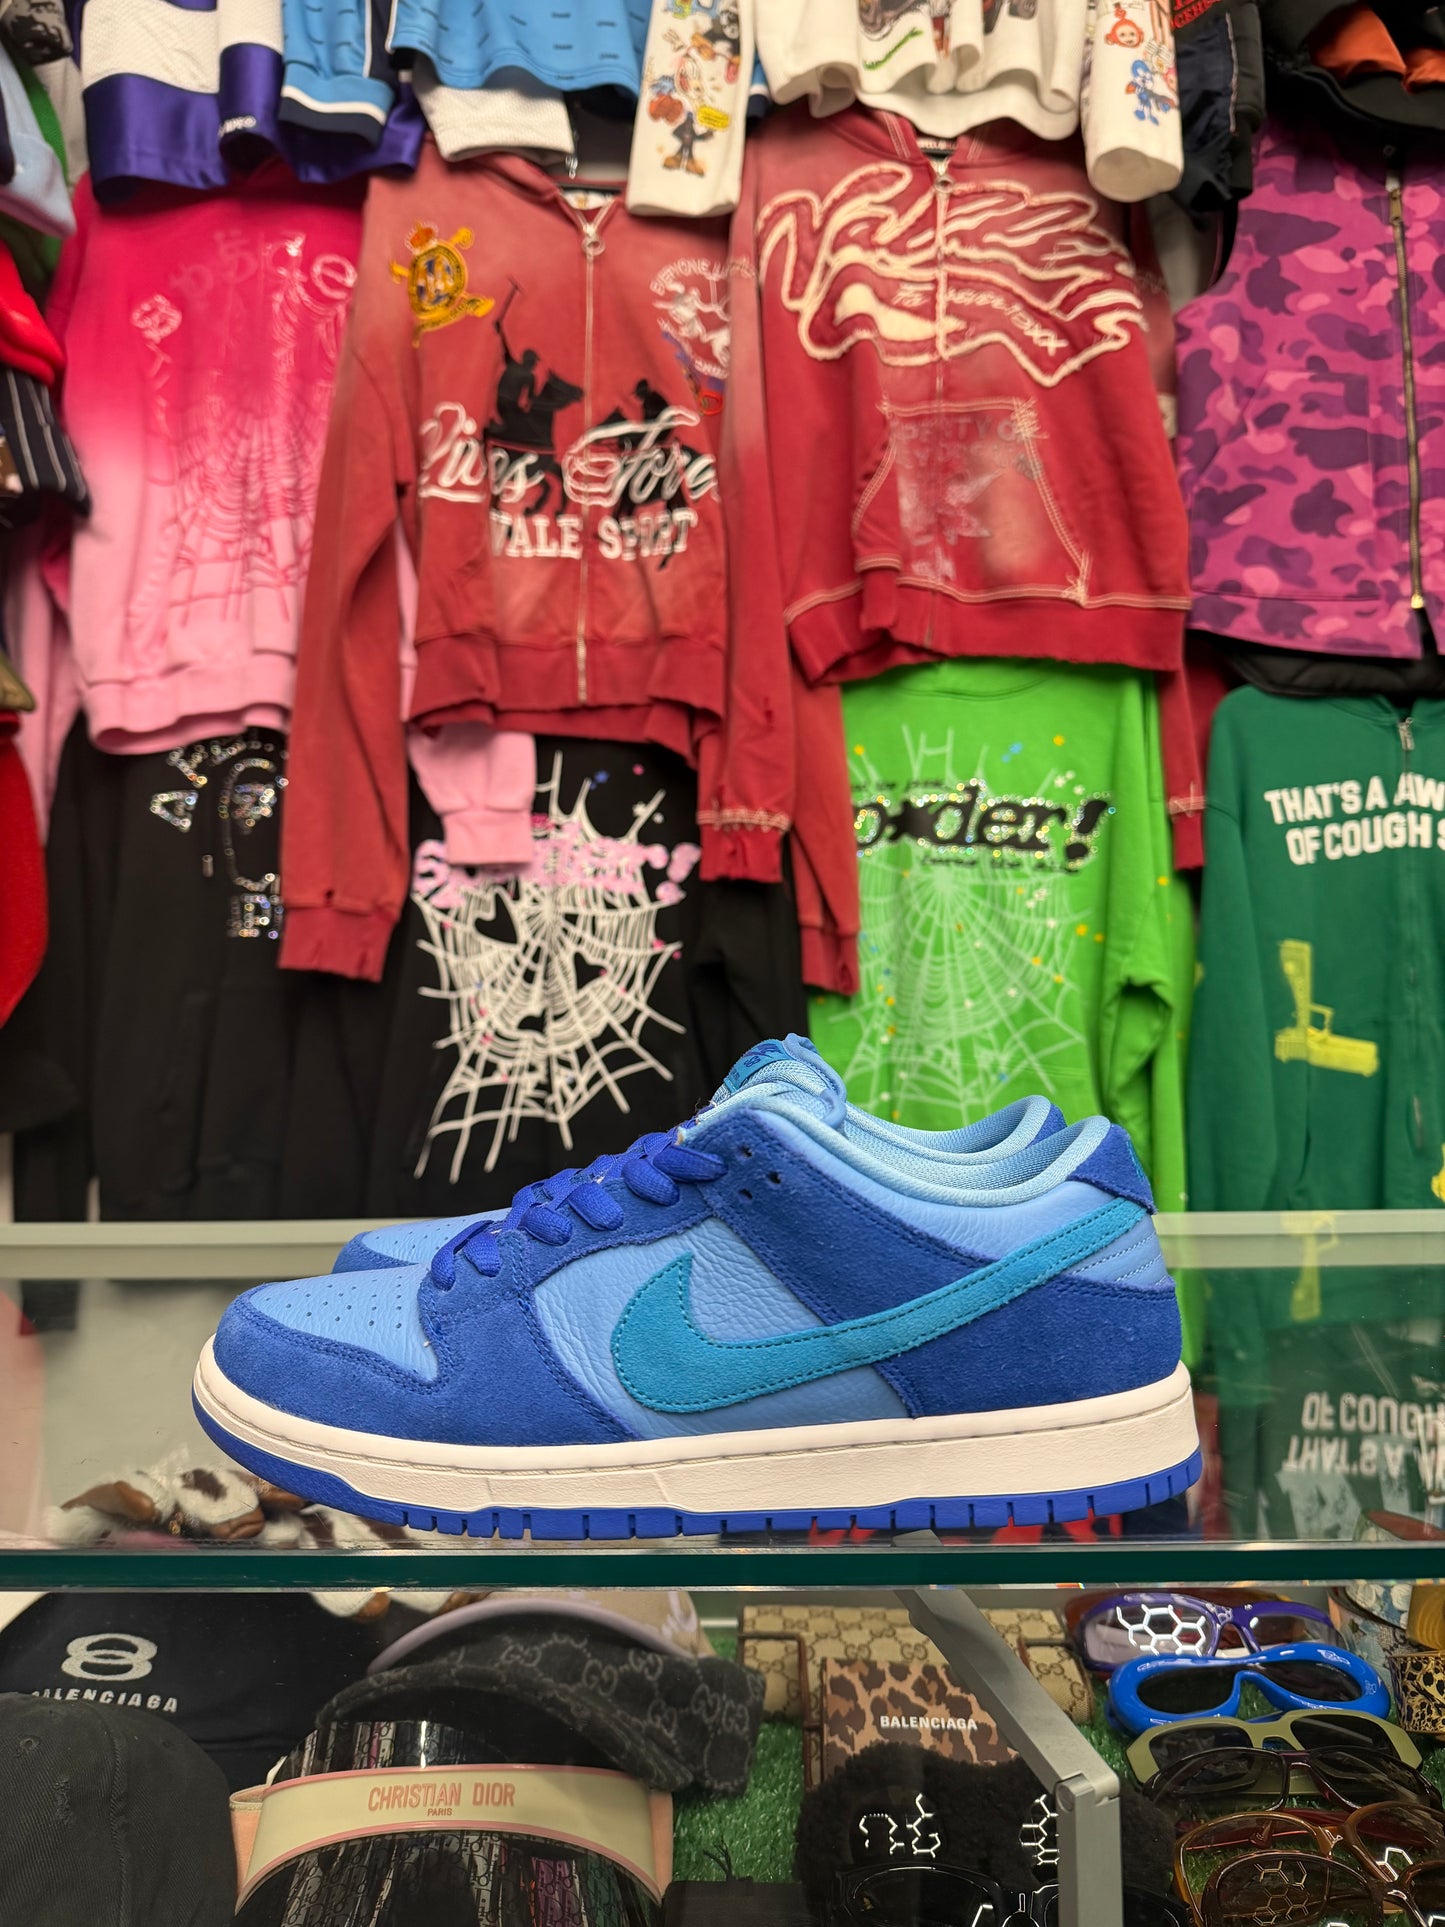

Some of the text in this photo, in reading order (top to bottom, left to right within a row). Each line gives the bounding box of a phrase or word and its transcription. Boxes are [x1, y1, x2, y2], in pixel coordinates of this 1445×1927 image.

[1263, 779, 1363, 825] THAT'S
[1365, 775, 1389, 811] A
[1285, 826, 1322, 865] OF
[1323, 811, 1433, 860] COUGH
[879, 1715, 978, 1731] BALENCIAGA
[367, 1781, 516, 1812] CHRISTIAN DIOR
[426, 1807, 453, 1817] PARIS
